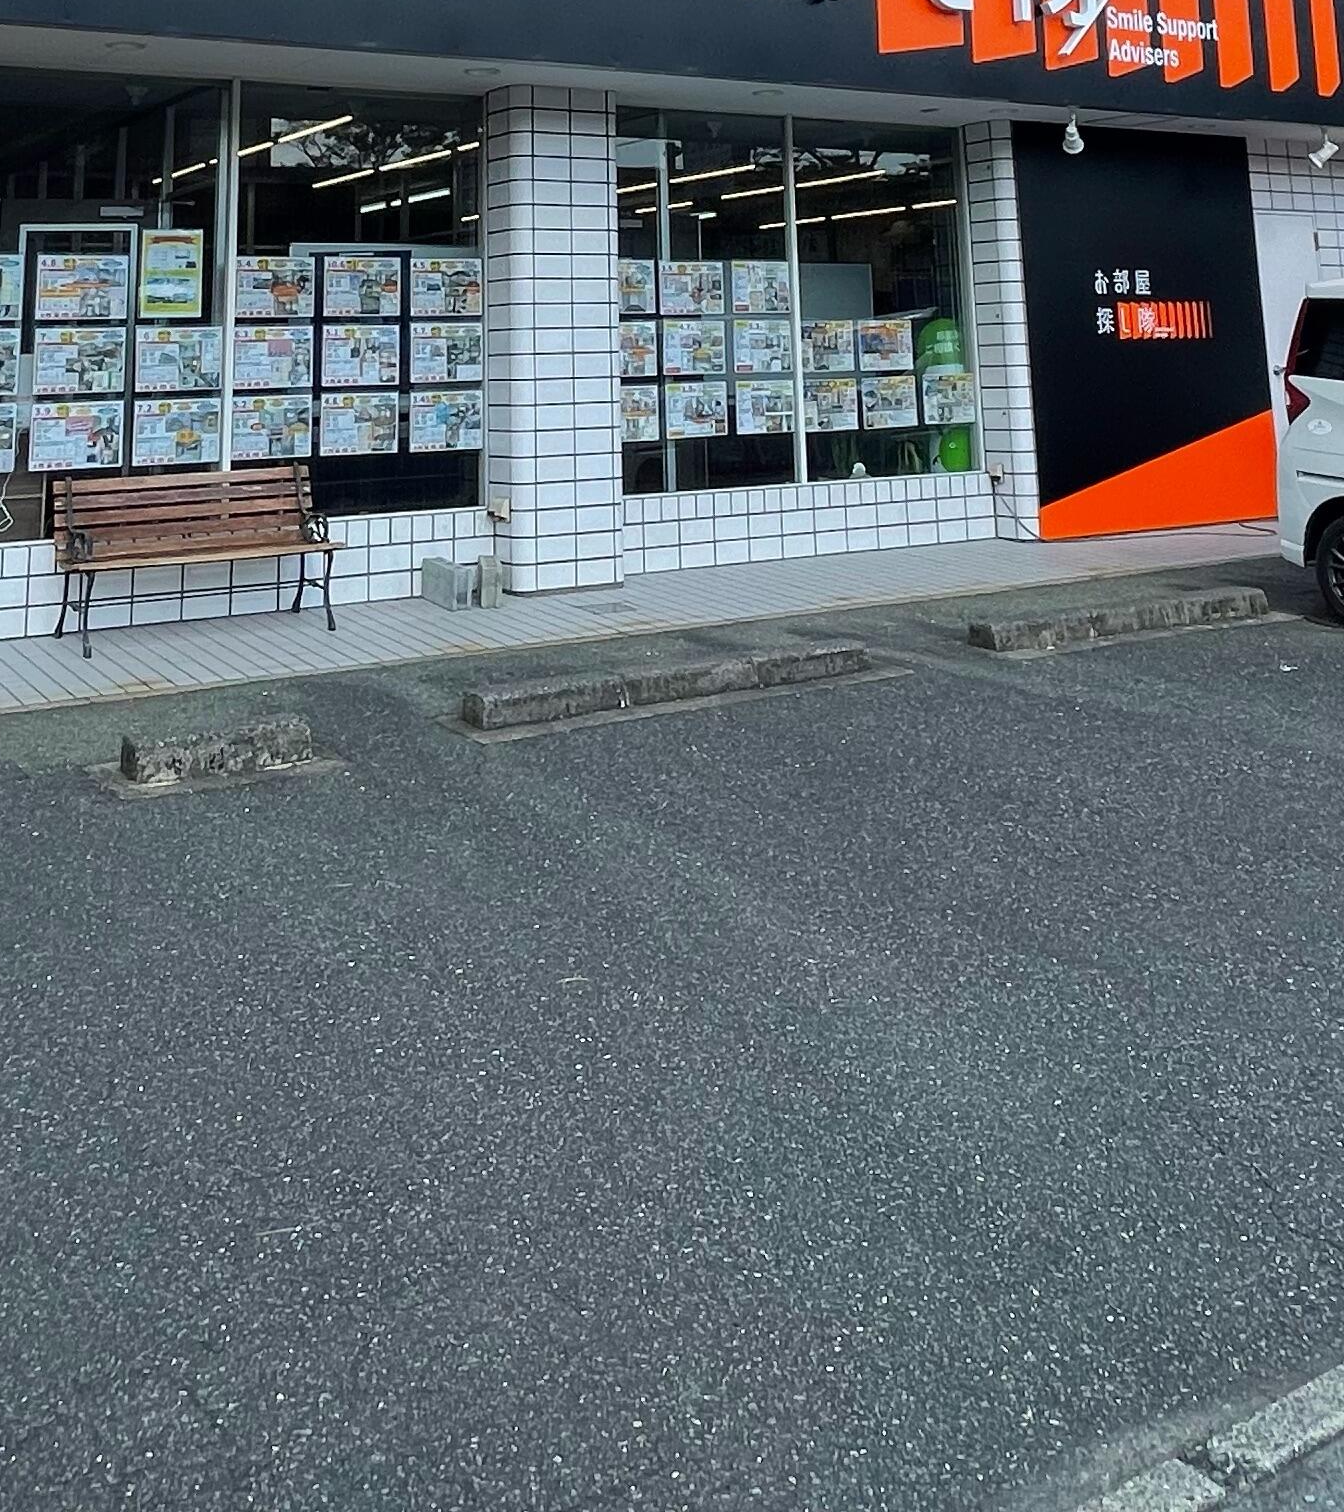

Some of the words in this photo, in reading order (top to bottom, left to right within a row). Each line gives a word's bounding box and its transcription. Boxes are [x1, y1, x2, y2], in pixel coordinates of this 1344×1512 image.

[1106, 6, 1153, 33] Smile
[1156, 11, 1219, 42] Support
[1109, 39, 1180, 68] Advisers
[1094, 268, 1152, 295] お部屋
